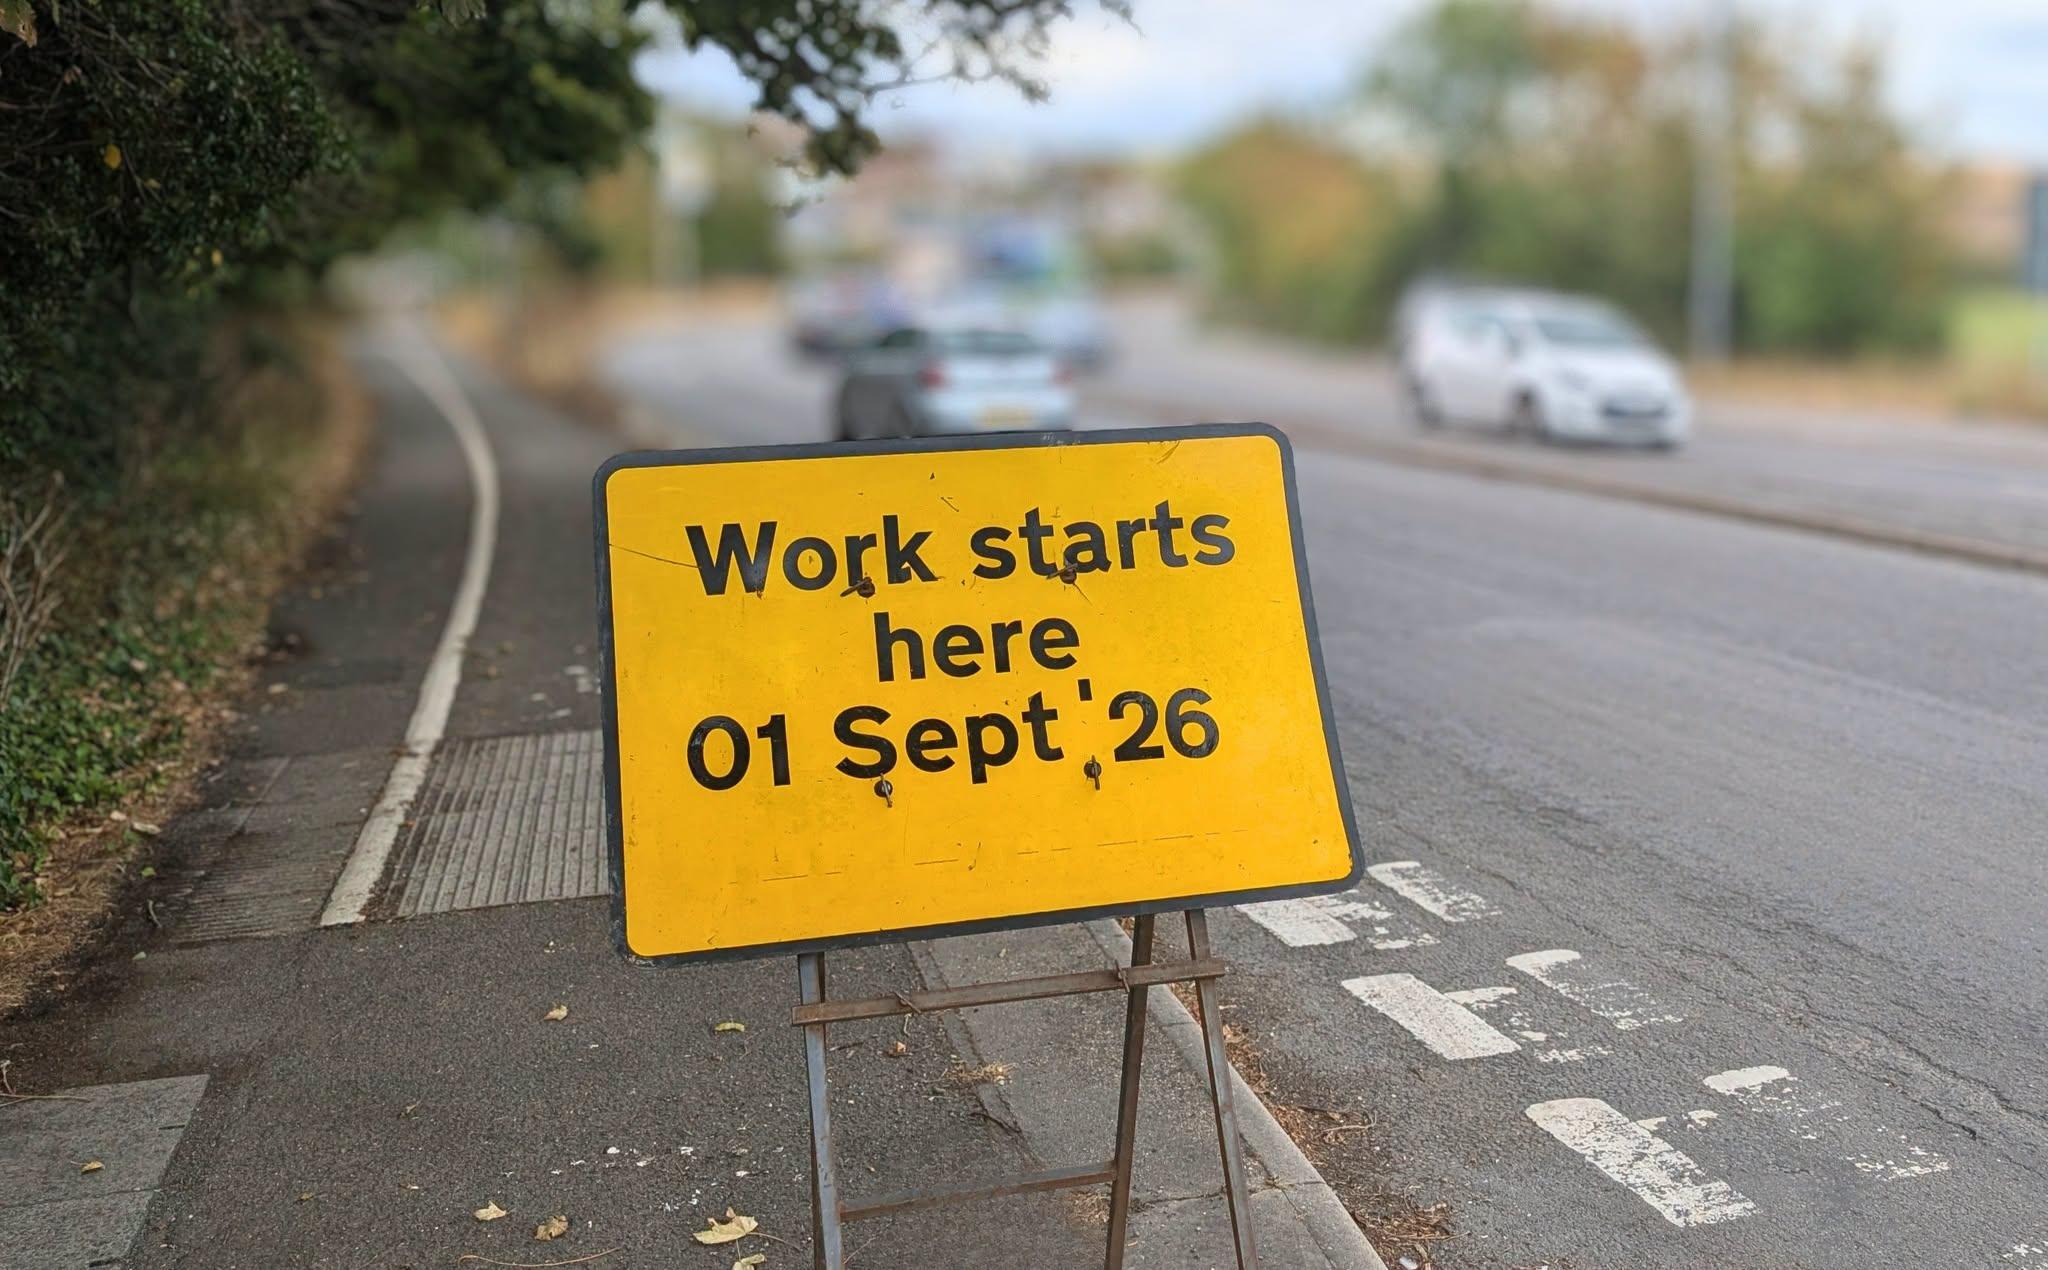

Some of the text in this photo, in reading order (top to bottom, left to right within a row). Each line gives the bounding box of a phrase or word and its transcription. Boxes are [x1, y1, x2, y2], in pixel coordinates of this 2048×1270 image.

[686, 501, 1235, 595] Work starts
[874, 612, 1079, 682] here
[687, 714, 790, 790] 01
[834, 692, 1064, 785] Sept
